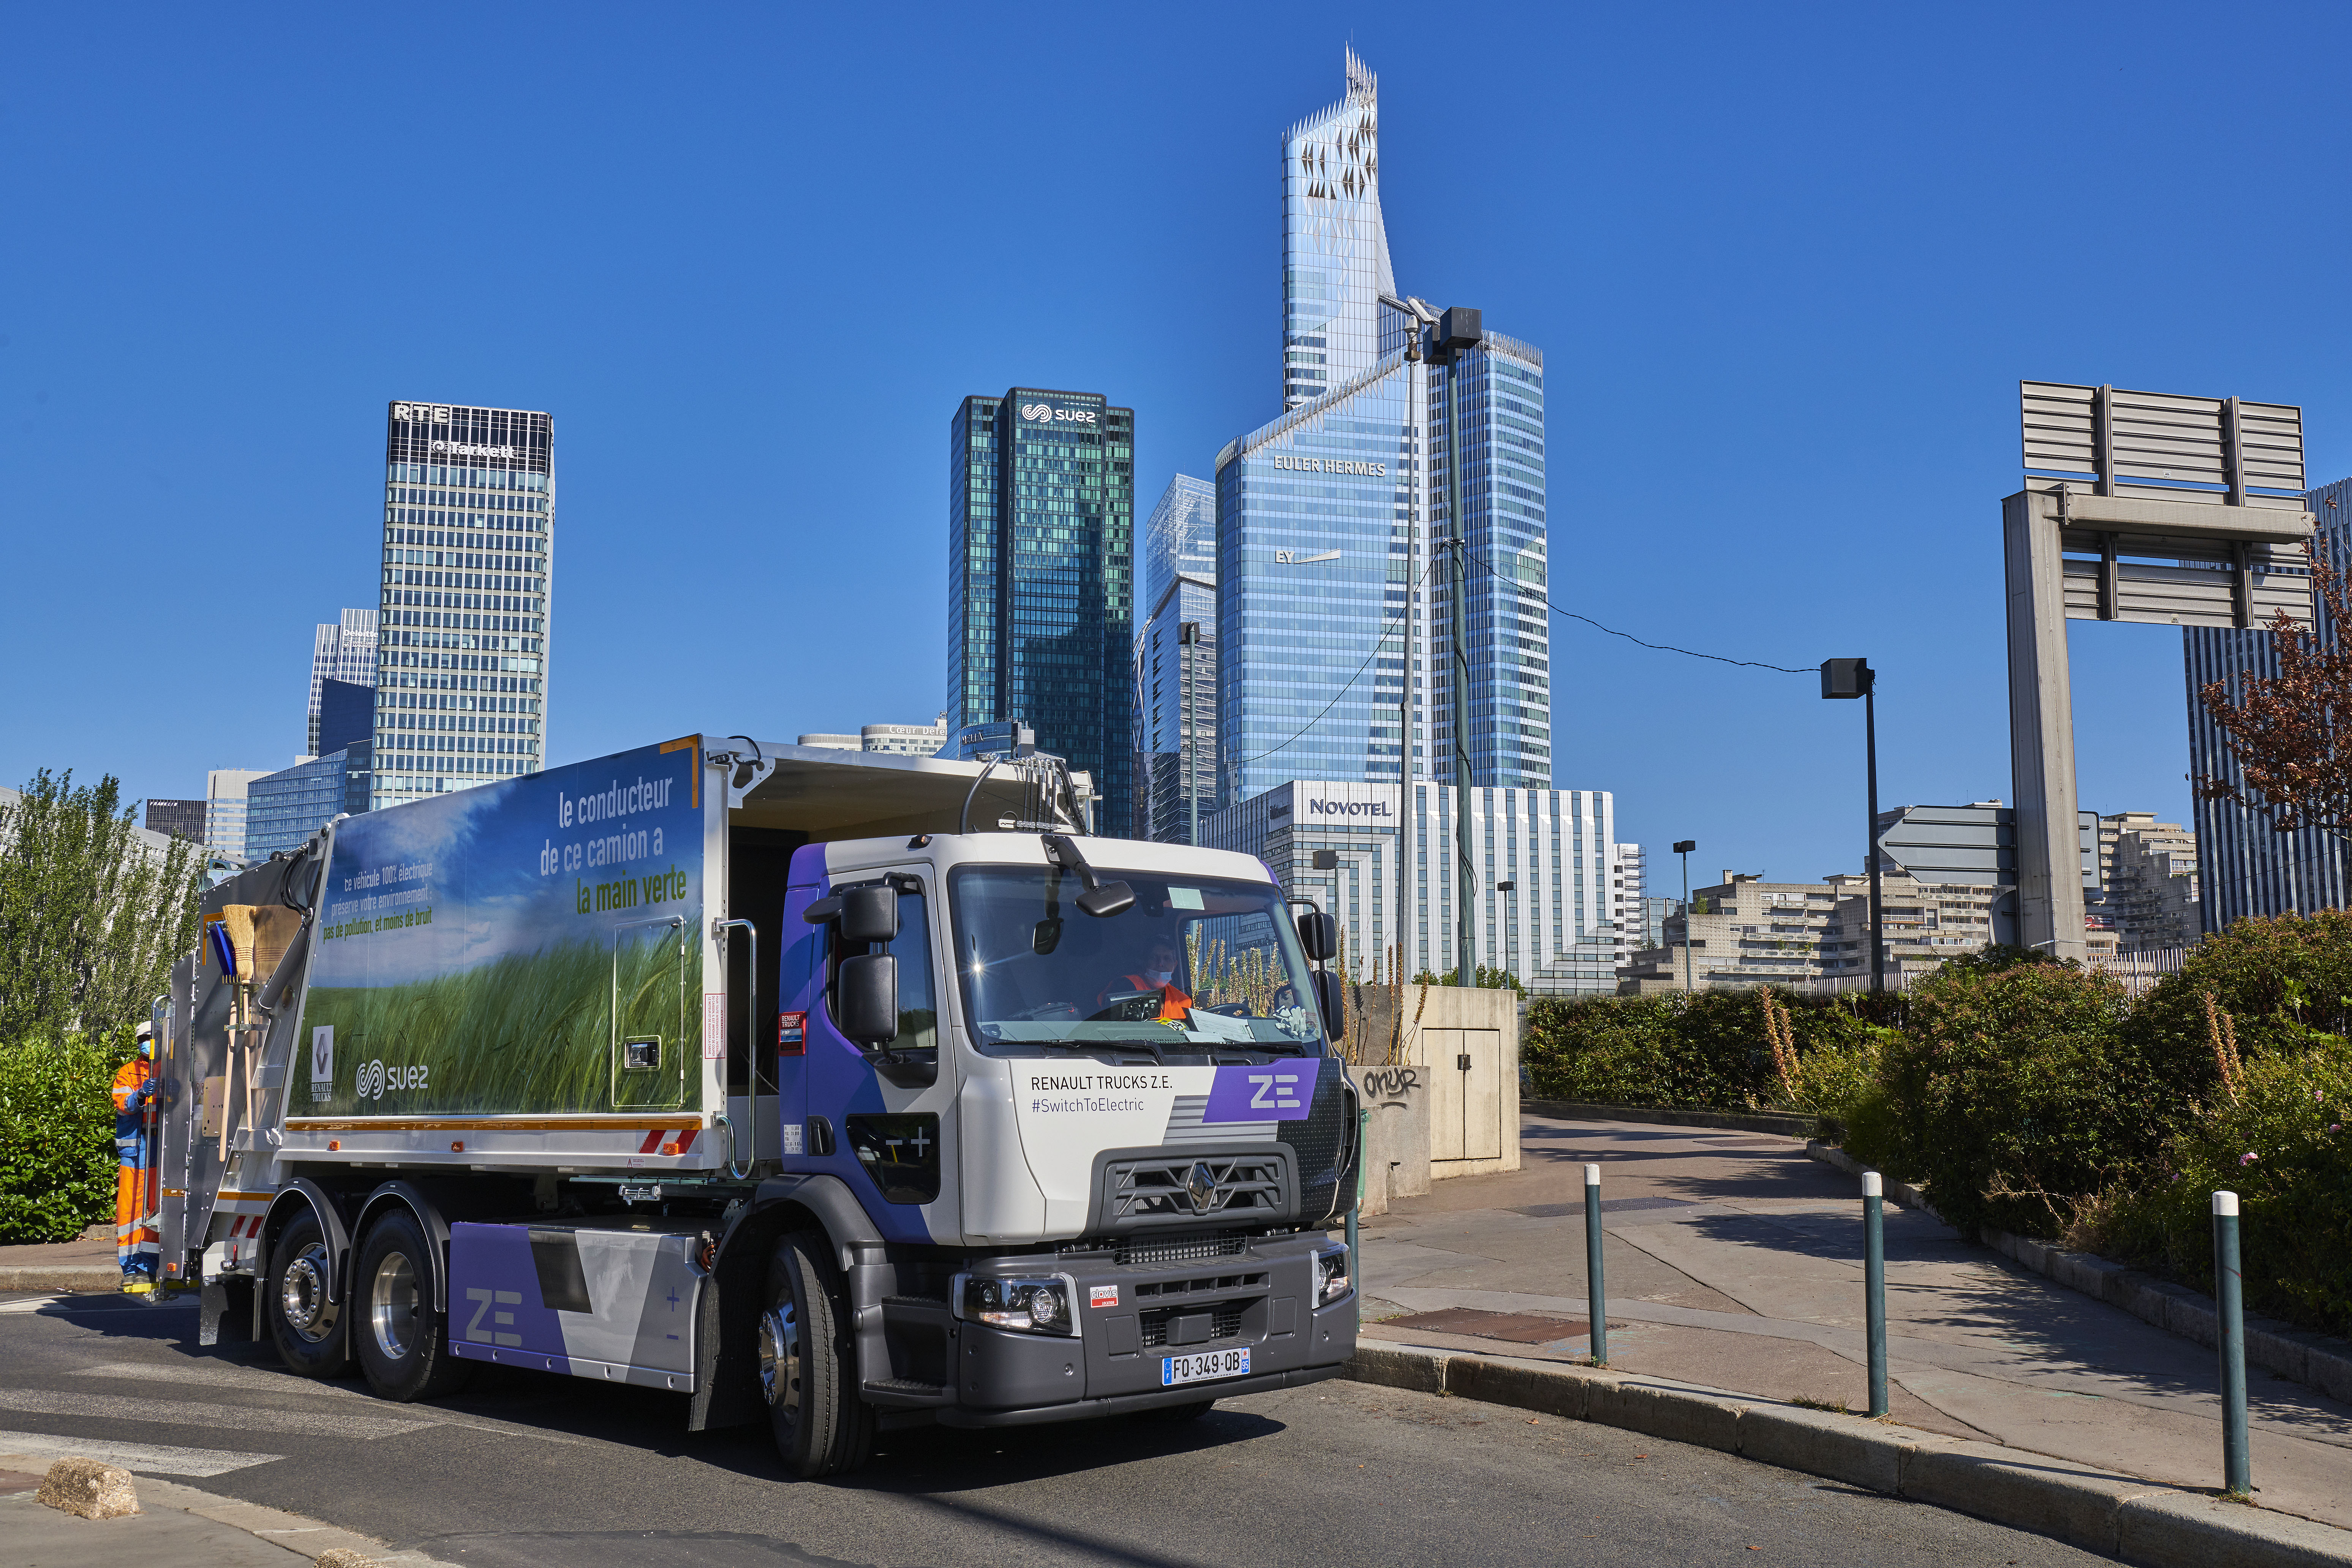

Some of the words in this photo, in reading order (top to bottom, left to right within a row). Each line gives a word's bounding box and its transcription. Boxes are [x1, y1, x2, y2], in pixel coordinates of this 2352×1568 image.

[394, 405, 448, 423] RTE
[1056, 409, 1096, 423] suez
[450, 441, 515, 458] Tarkett
[1275, 456, 1320, 472] EULER
[1325, 460, 1386, 477] HERMES
[1276, 550, 1295, 564] EY
[343, 629, 378, 638] Deloitte
[559, 792, 572, 828] le
[579, 776, 673, 824] conducteur
[1310, 799, 1393, 816] NOVOTEL
[541, 839, 558, 876] de
[564, 842, 582, 872] ce
[588, 824, 647, 868] camion
[654, 827, 663, 855] a
[345, 877, 352, 892] ce
[354, 869, 379, 890] véhicule
[382, 864, 397, 885] 100%
[399, 860, 432, 883] électrique
[577, 878, 590, 915] la
[596, 870, 637, 912] main
[643, 864, 686, 904] verte
[332, 898, 358, 921] préserve
[360, 893, 376, 910] votre
[379, 884, 428, 909] environnement
[324, 926, 334, 945] pas
[336, 920, 343, 937] de
[345, 916, 373, 941] pollution,
[375, 917, 382, 932] et
[384, 912, 403, 931] moins
[405, 909, 414, 928] de
[416, 906, 432, 926] bruit
[387, 1065, 428, 1090] suez
[1031, 1076, 1092, 1090] RENAULT
[1097, 1075, 1147, 1089] TRUCKS
[1151, 1075, 1173, 1089] Z.E.
[311, 1082, 332, 1092] RENAULT
[1249, 1075, 1301, 1109] ZE
[312, 1092, 331, 1102] TRUCKS
[1032, 1097, 1144, 1113] #SwitchToElectric
[1091, 1287, 1117, 1299] clovis
[466, 1288, 522, 1347] ZE
[1174, 1351, 1240, 1379] FQ-349-QB
[1242, 1361, 1249, 1370] 95
